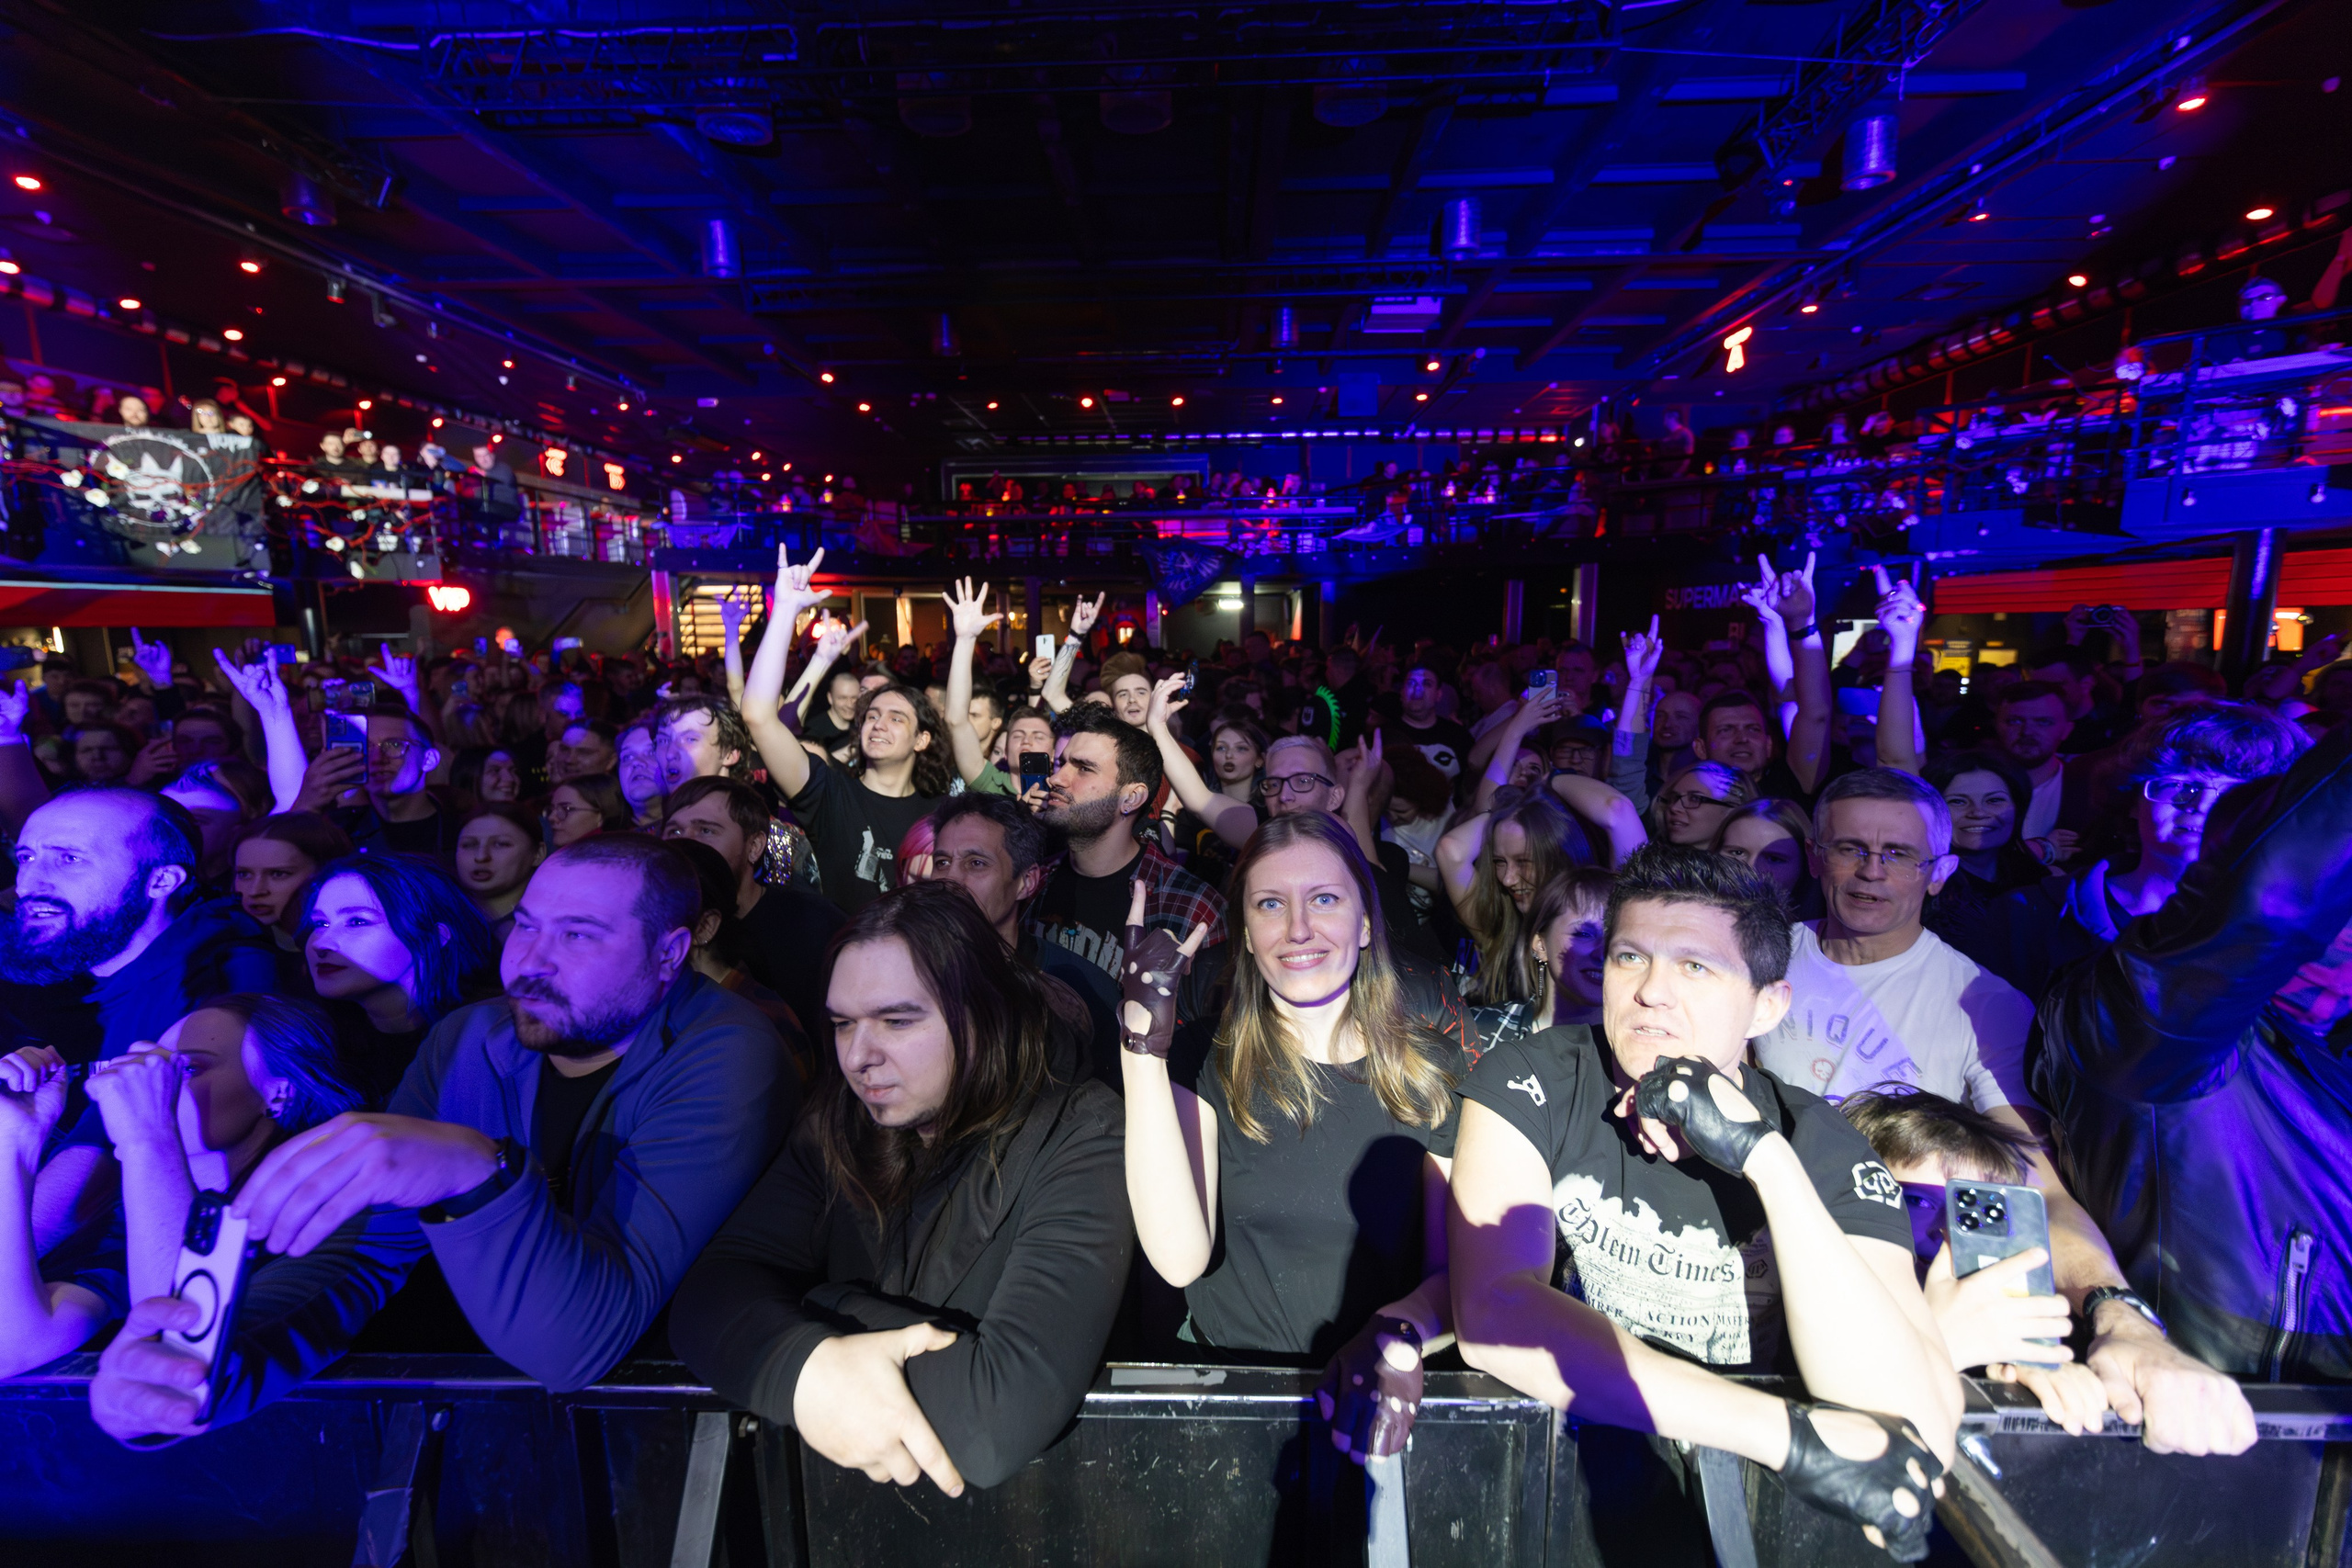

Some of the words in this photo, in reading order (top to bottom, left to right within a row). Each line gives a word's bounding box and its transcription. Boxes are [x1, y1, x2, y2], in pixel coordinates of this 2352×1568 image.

[428, 586, 470, 612] VIP
[1665, 581, 1763, 610] SUPERMA
[1646, 1311, 1711, 1327] ACTION
